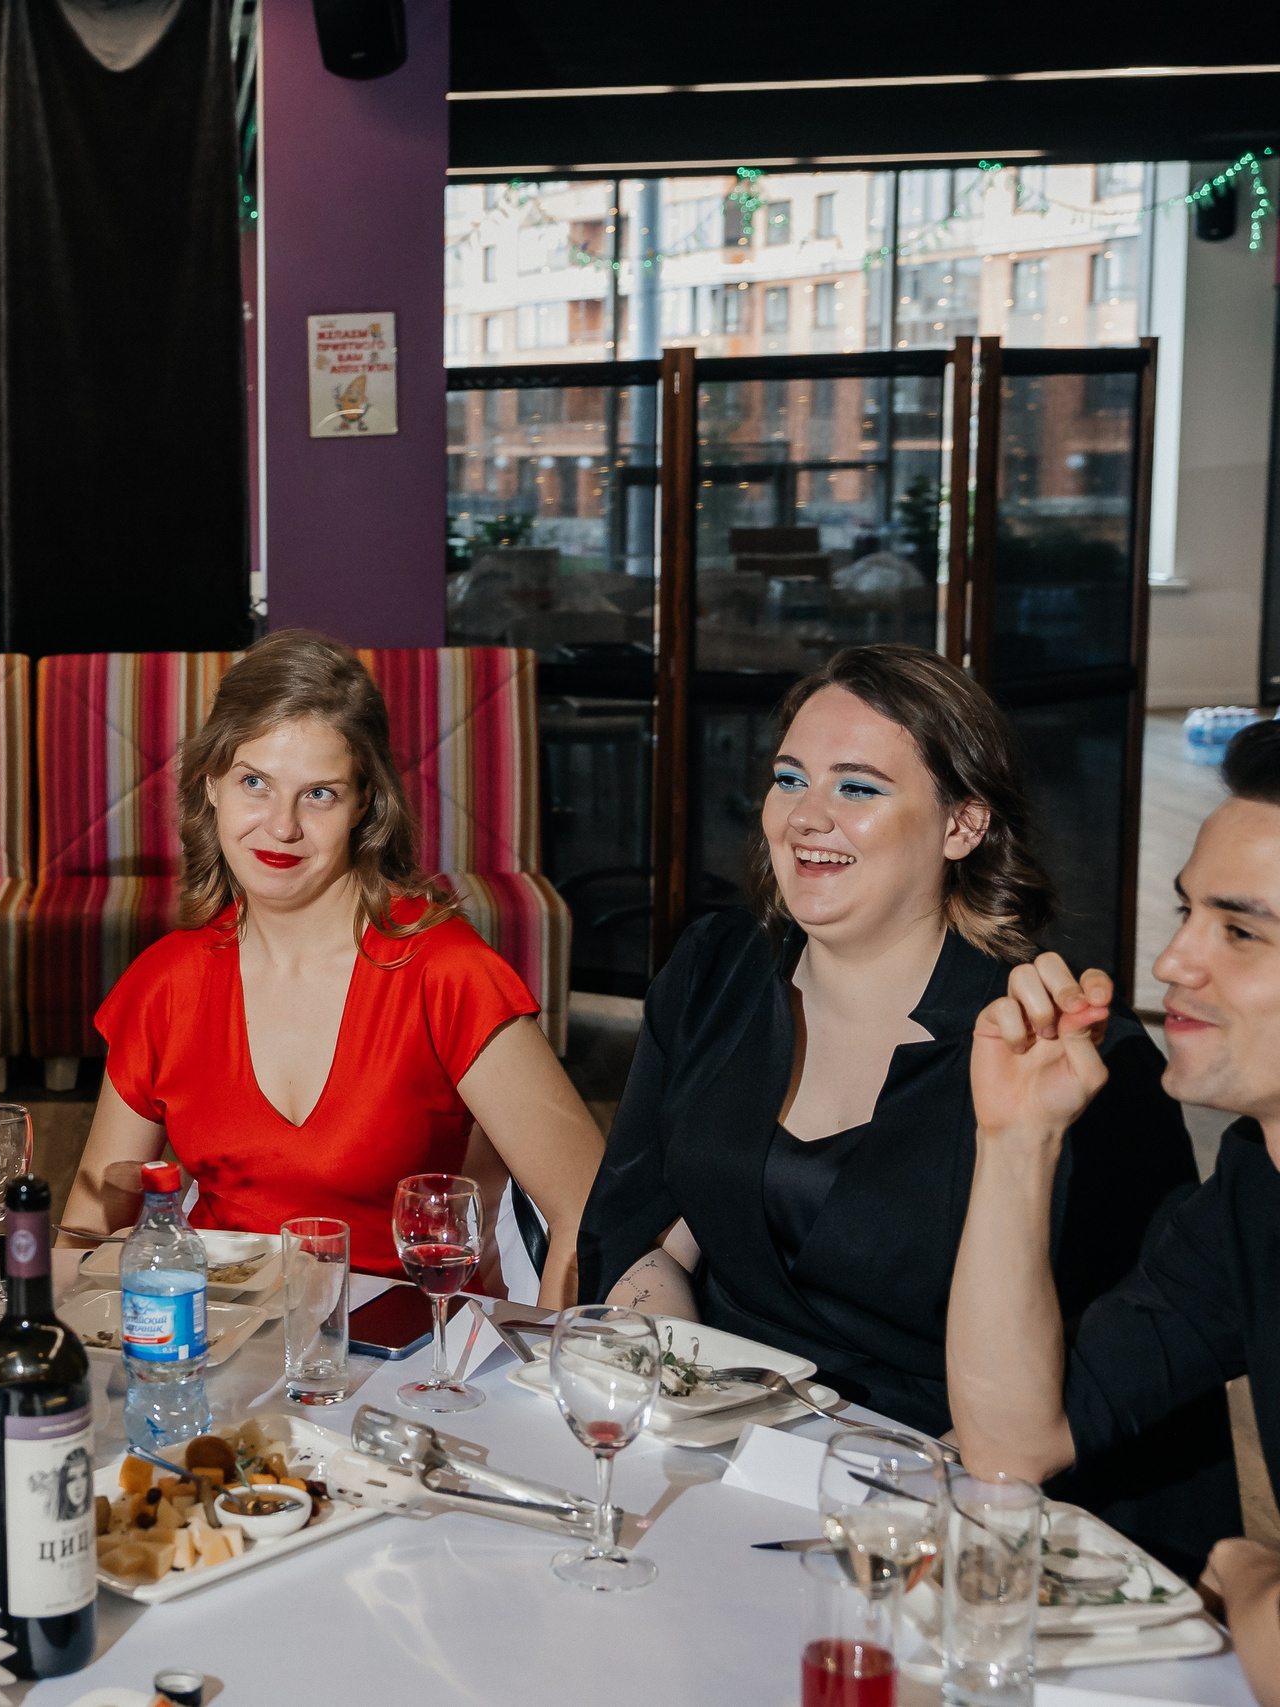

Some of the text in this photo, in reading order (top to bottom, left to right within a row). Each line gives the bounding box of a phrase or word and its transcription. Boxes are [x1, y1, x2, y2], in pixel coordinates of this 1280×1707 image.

[317, 330, 369, 340] ЖЕЛАЕМ
[317, 340, 387, 351] ПРИЯТНОГО
[337, 353, 364, 362] ВАМ
